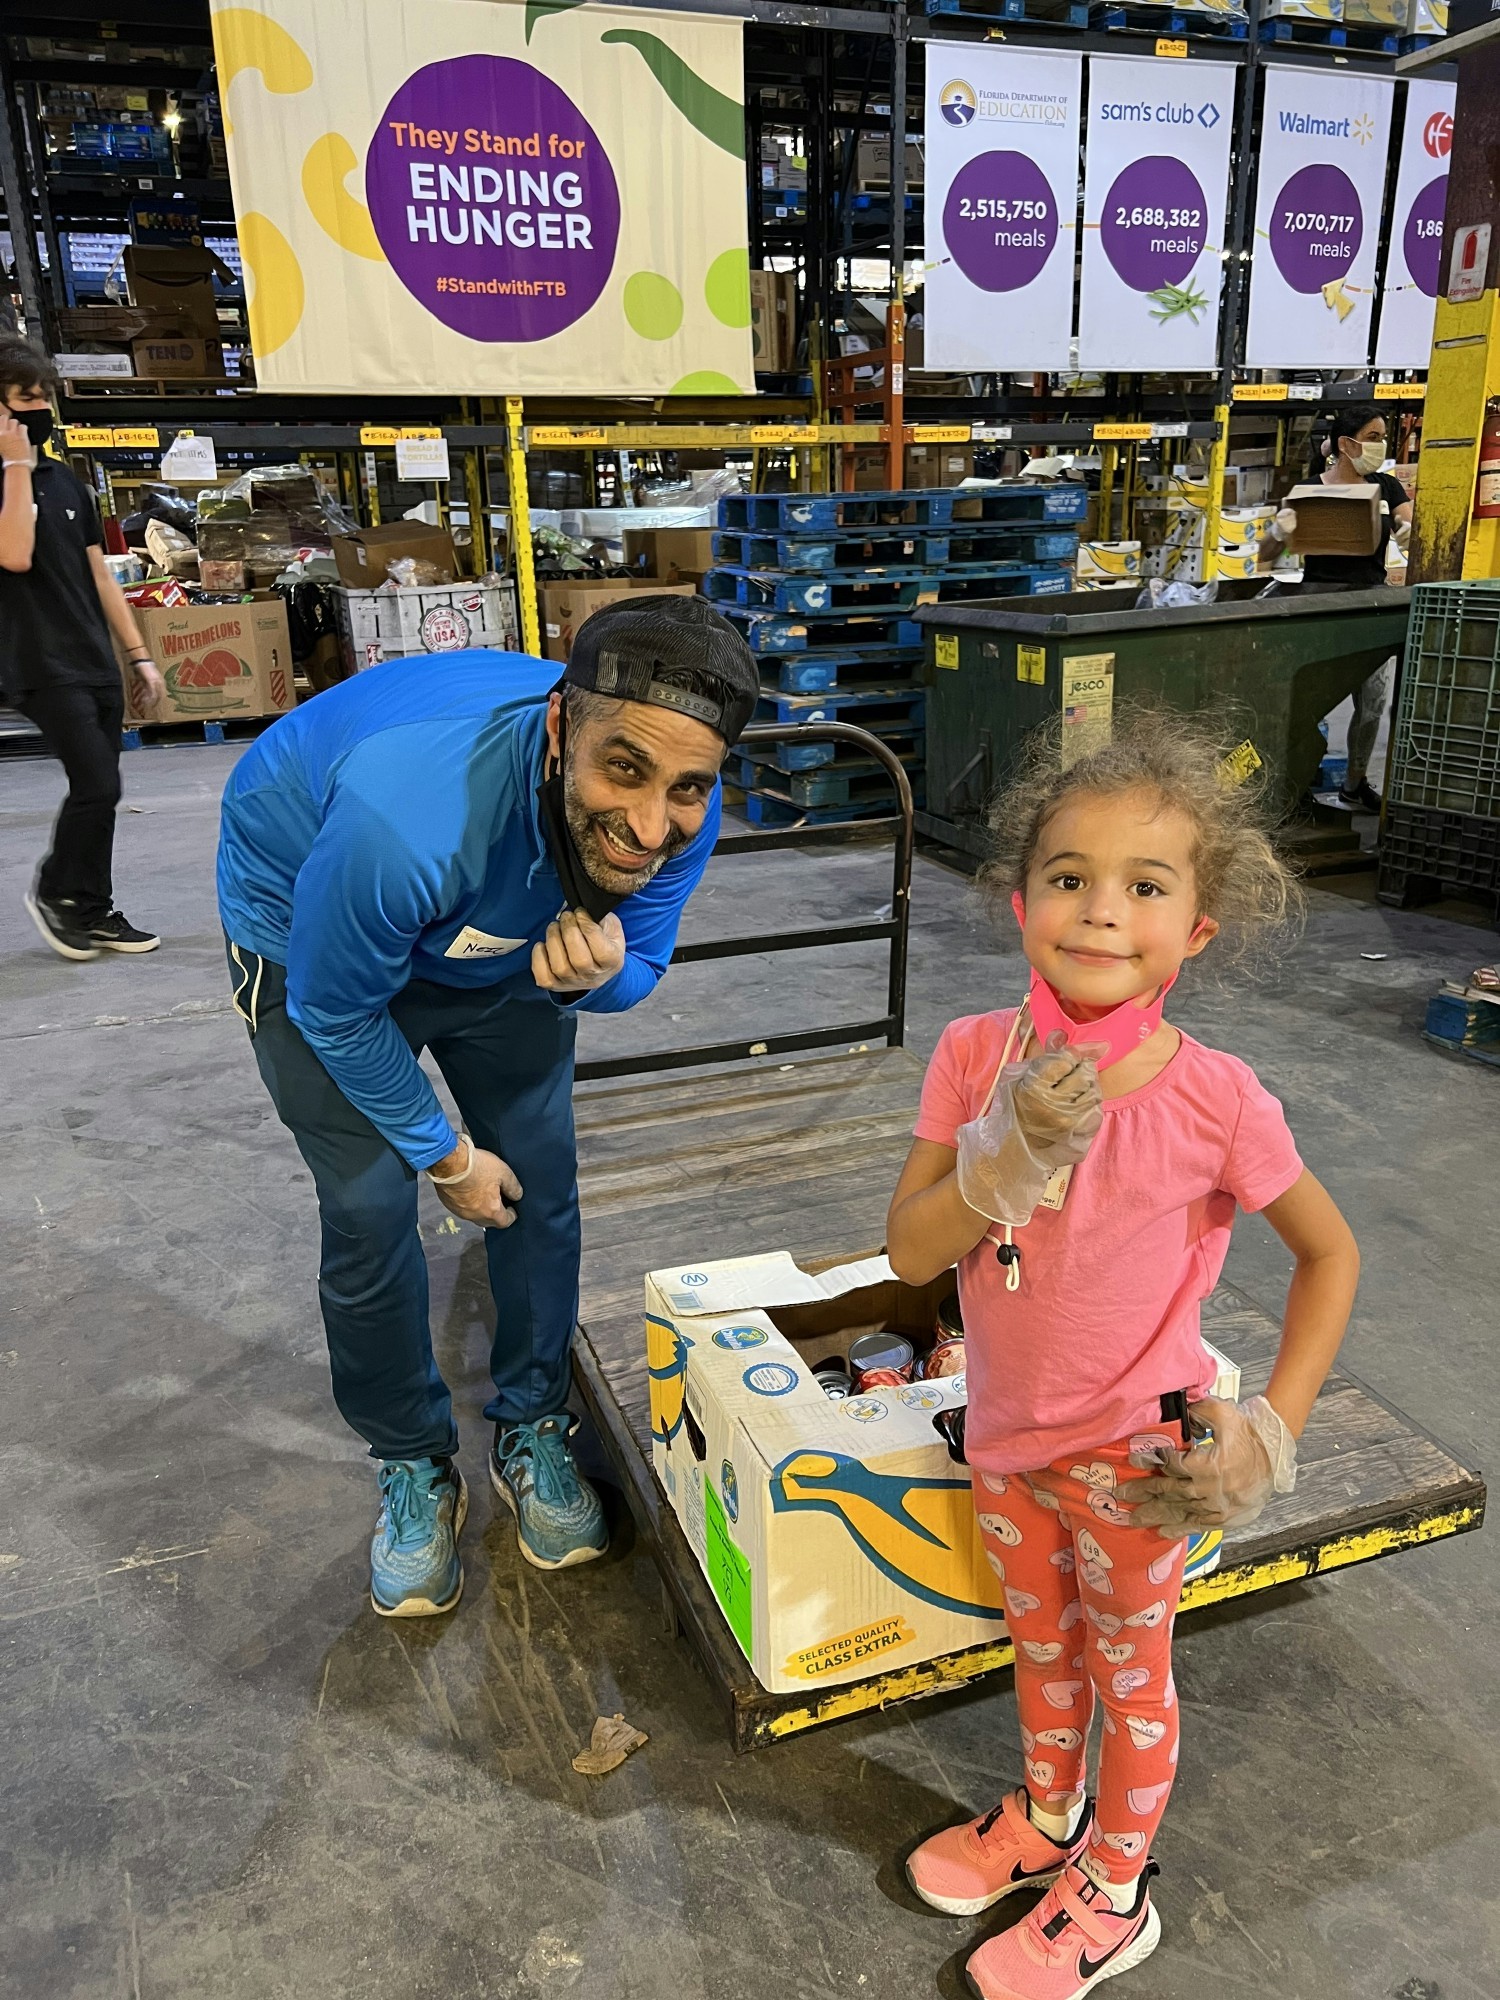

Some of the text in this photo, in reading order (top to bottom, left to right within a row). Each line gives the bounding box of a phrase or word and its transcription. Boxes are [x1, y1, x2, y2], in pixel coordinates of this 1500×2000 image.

[979, 89, 1068, 104] FLORIDA DEPARTMENT OF
[979, 101, 1067, 120] EDUCATION
[1101, 102, 1195, 124] sam's club
[1279, 111, 1351, 138] Walmart
[389, 122, 586, 159] They Stand for
[409, 162, 583, 209] ENDING
[958, 198, 1047, 222] 2,515,750
[1115, 206, 1201, 229] 2,688,382
[406, 205, 594, 250] HUNGER
[1284, 212, 1355, 235] 7,070,717
[995, 230, 1047, 248] meals
[1150, 236, 1199, 254] meals
[1309, 241, 1351, 258] meals
[436, 276, 567, 297] #StandwithFTB
[167, 619, 189, 632] Fresh
[434, 629, 458, 643] USA
[160, 620, 242, 656] WATERMELONS
[1068, 679, 1105, 697] jesco
[798, 1619, 900, 1663] SELECTED QUALITY
[805, 1631, 902, 1675] CLASS EXTRA
